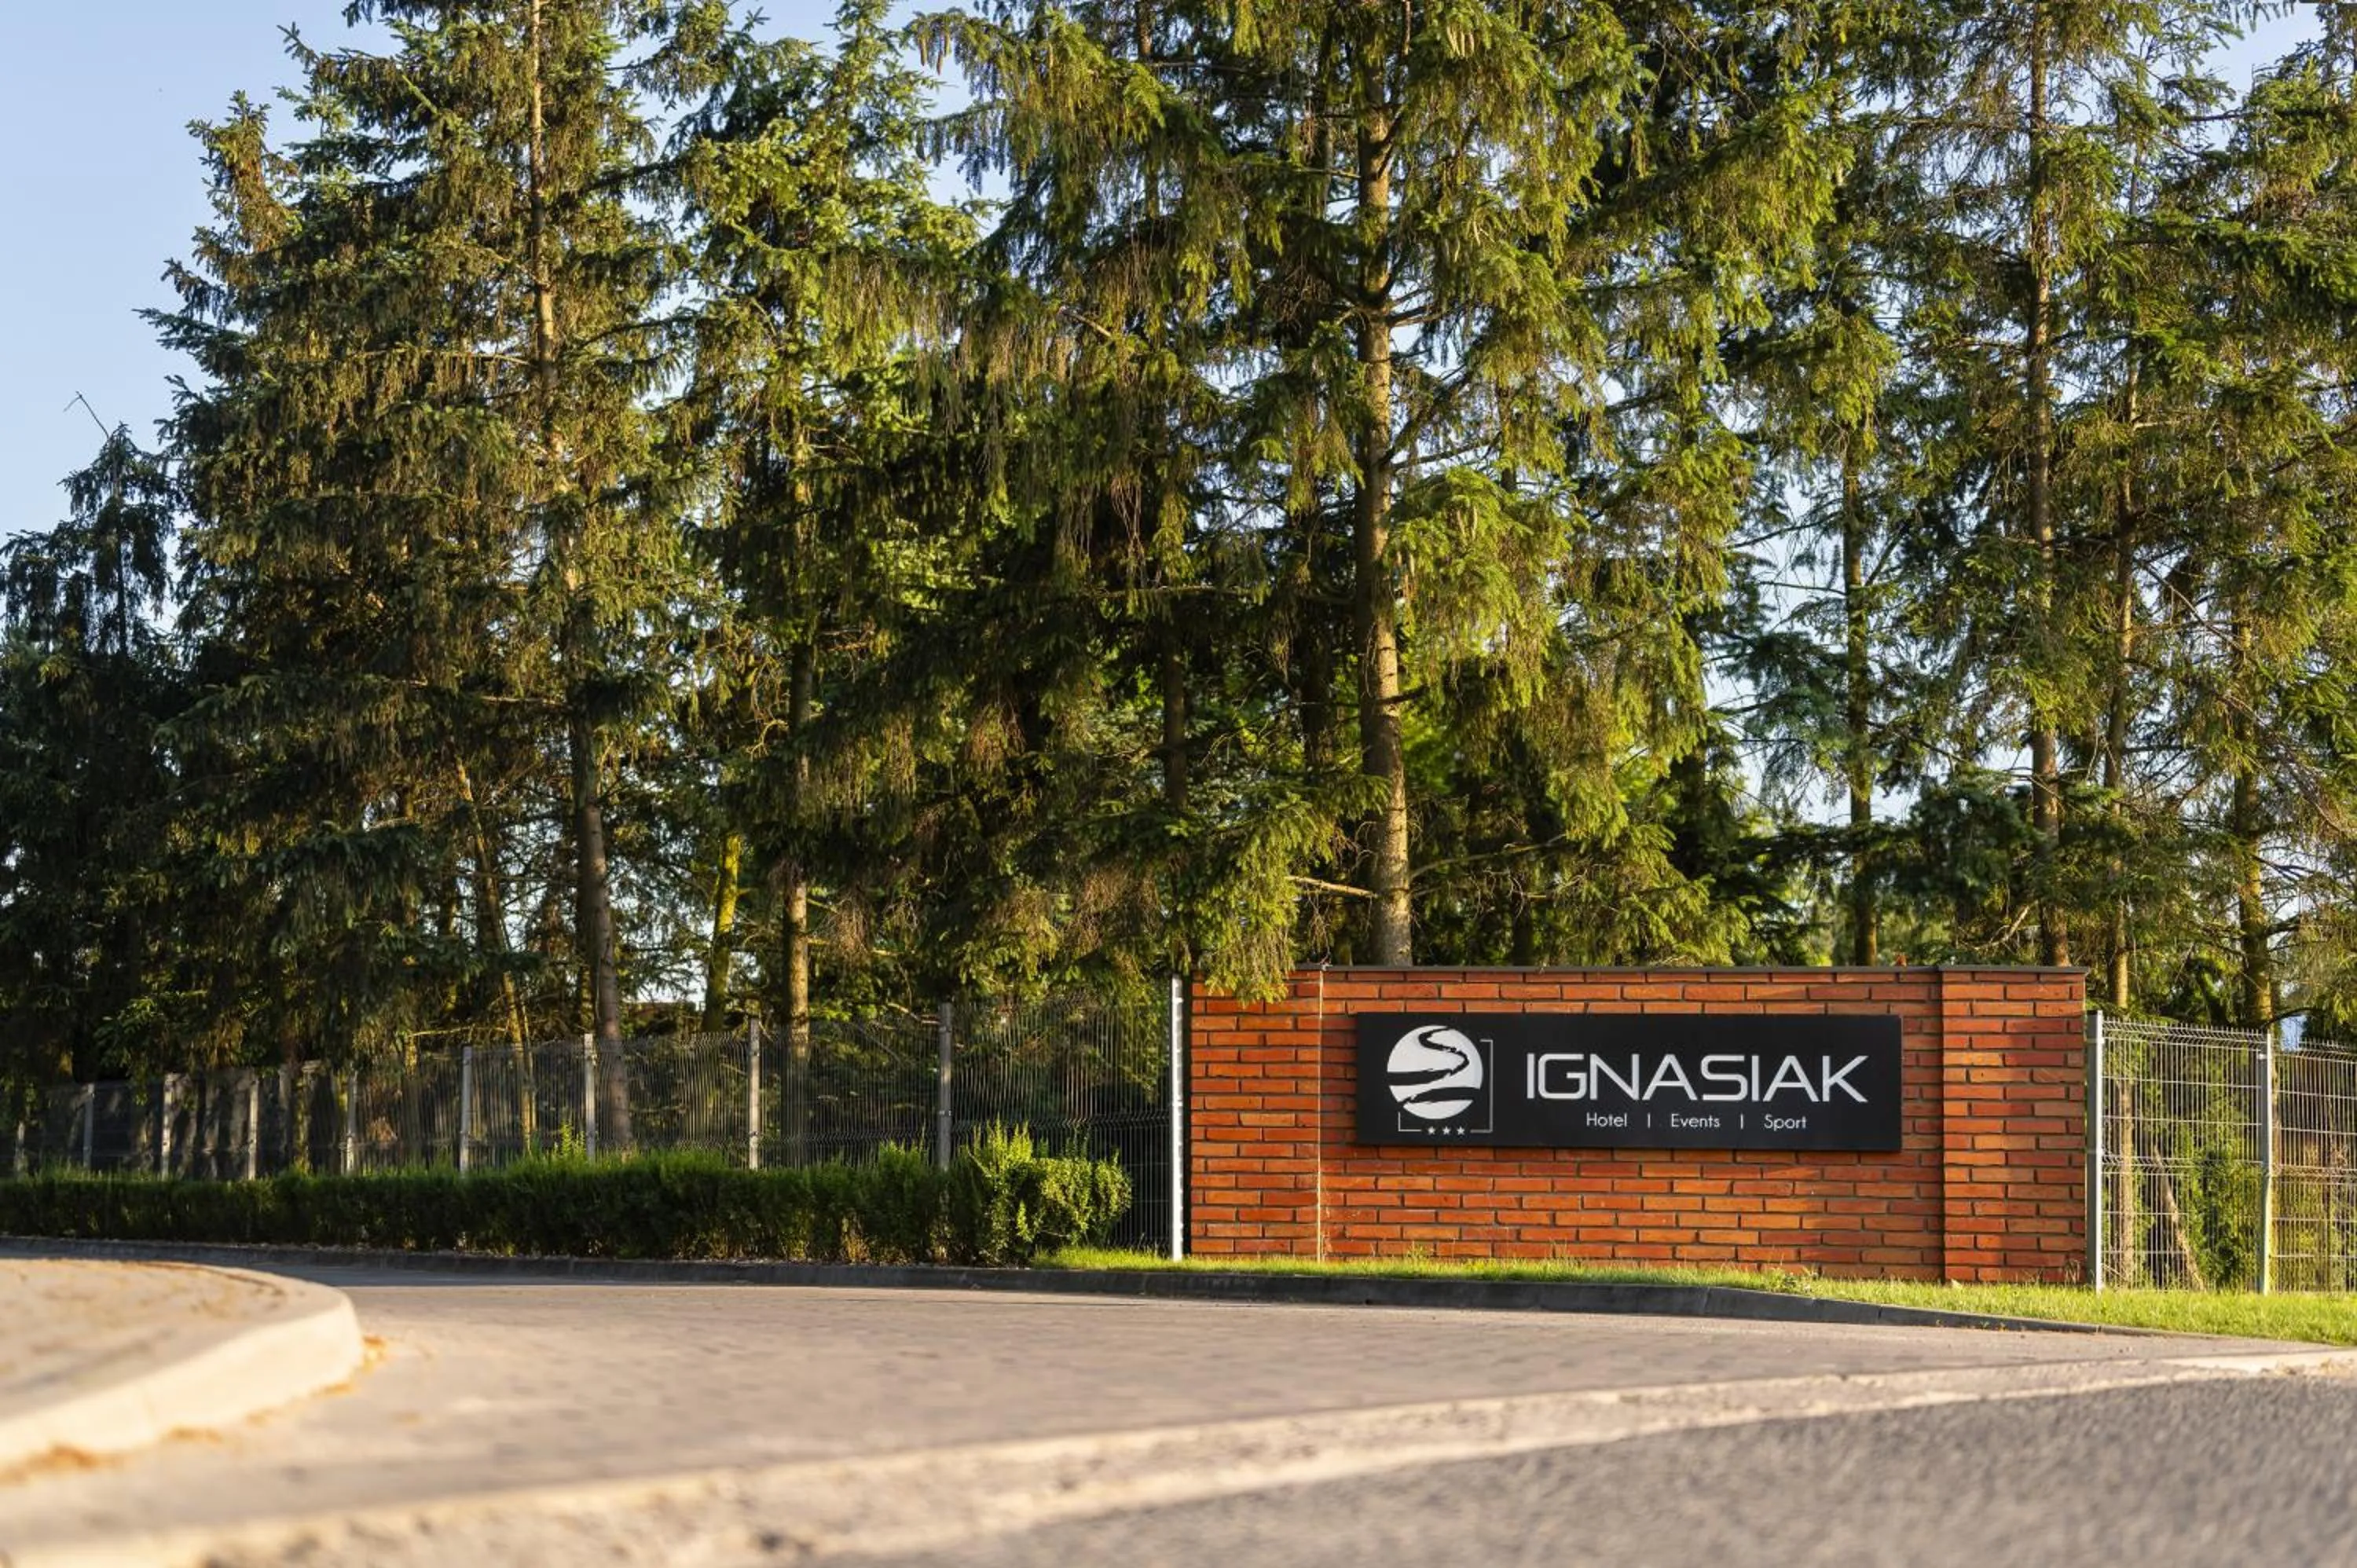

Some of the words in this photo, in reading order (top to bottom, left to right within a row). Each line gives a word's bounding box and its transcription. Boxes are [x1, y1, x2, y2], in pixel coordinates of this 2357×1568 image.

[1526, 1053, 1868, 1103] IGNASIAK
[1585, 1112, 1628, 1128] Hotel
[1670, 1113, 1721, 1129] Events
[1763, 1114, 1807, 1131] Sport
